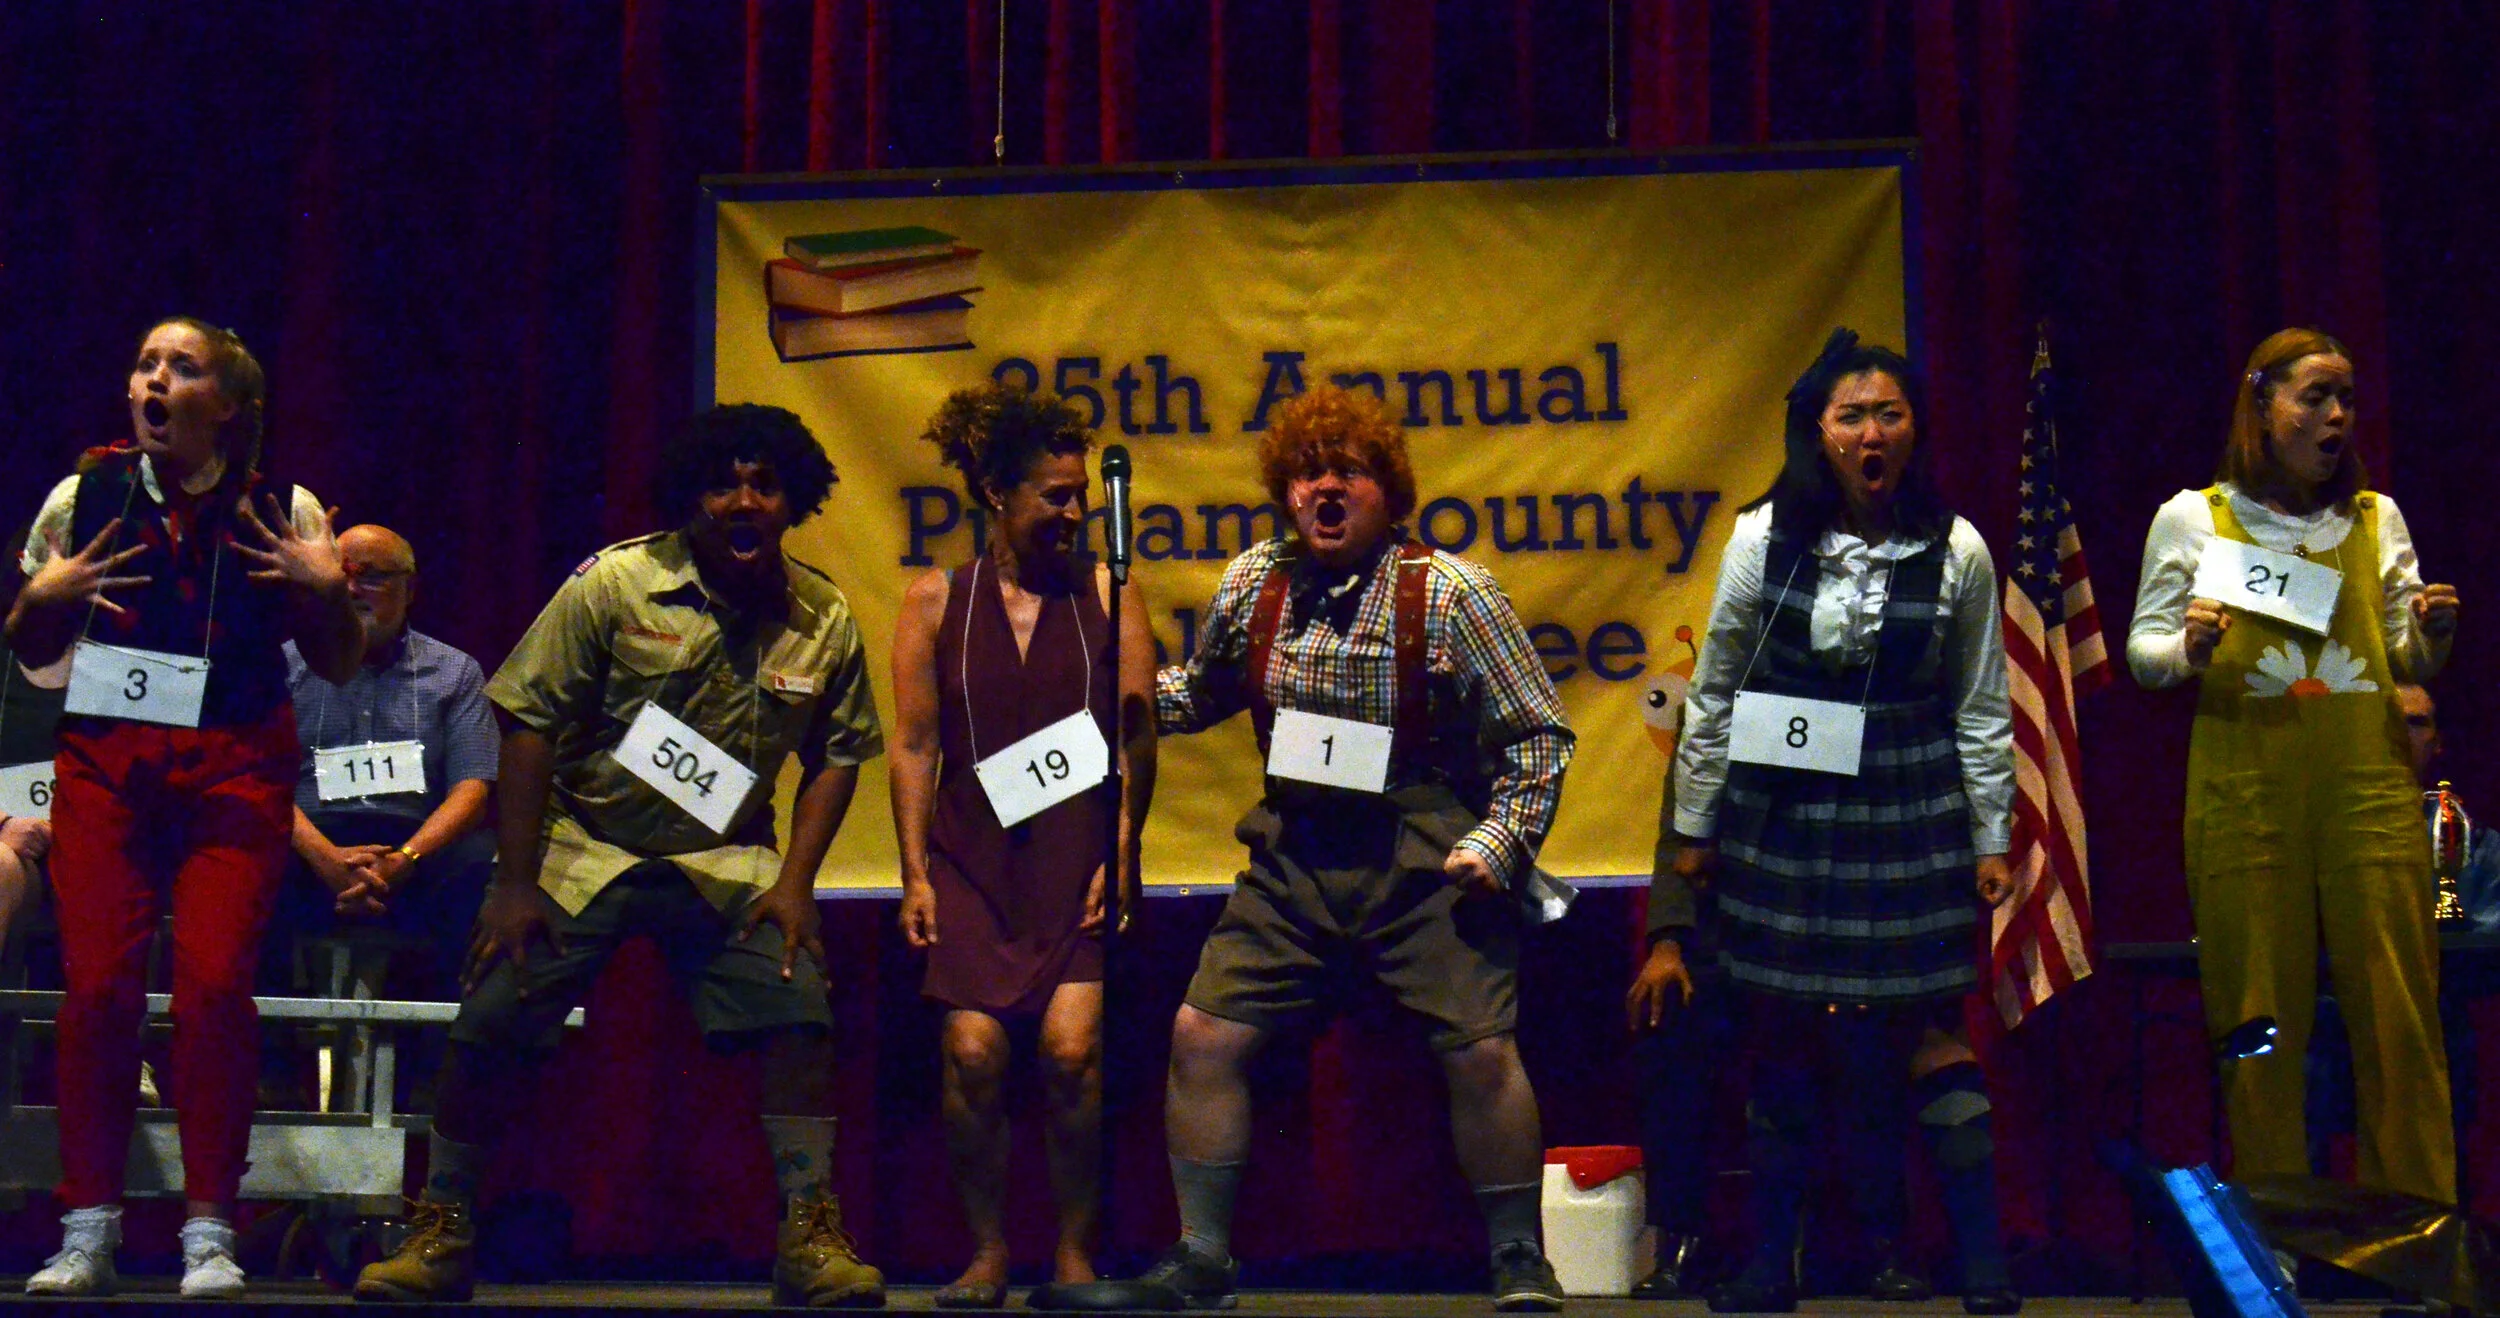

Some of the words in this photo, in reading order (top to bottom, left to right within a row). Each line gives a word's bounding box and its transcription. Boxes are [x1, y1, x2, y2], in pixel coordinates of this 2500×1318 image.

[1398, 476, 1720, 573] ounty
[2245, 564, 2290, 597] 21
[1527, 621, 1646, 682] ee
[123, 668, 148, 701] 3
[1786, 715, 1808, 749] 8
[651, 736, 721, 798] 504
[1321, 735, 1336, 766] 1
[343, 755, 396, 783] 111
[1025, 748, 1071, 789] 19
